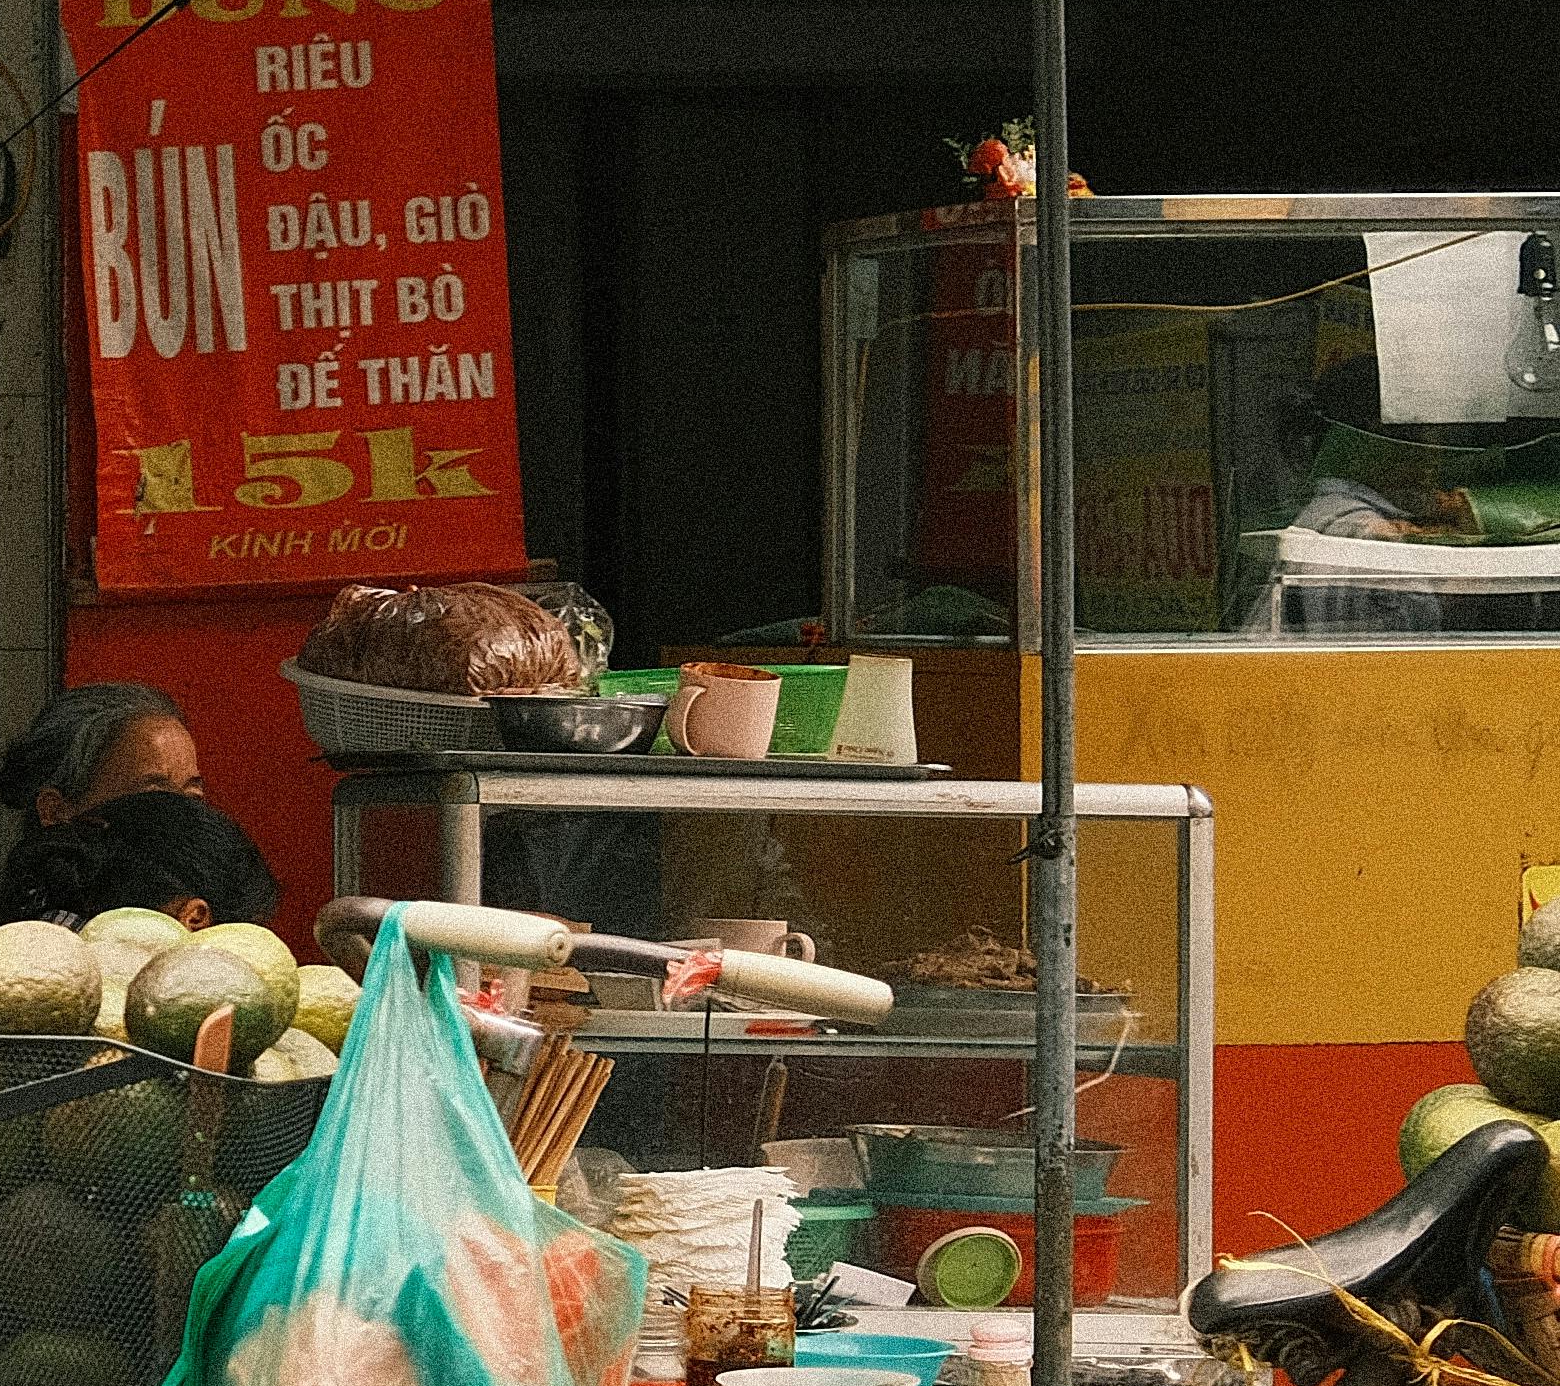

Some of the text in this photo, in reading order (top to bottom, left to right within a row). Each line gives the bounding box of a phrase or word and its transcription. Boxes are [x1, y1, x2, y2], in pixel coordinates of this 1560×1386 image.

[257, 34, 372, 92] RIÊU
[260, 107, 328, 173] ỐC
[88, 100, 247, 359] BÚN
[267, 183, 490, 259] ĐẬU, GIÒ
[271, 264, 465, 337] THỊT BÒ
[359, 345, 494, 404] THĂN
[115, 426, 496, 517] 15k
[209, 524, 408, 559] KÍNH MỜI
